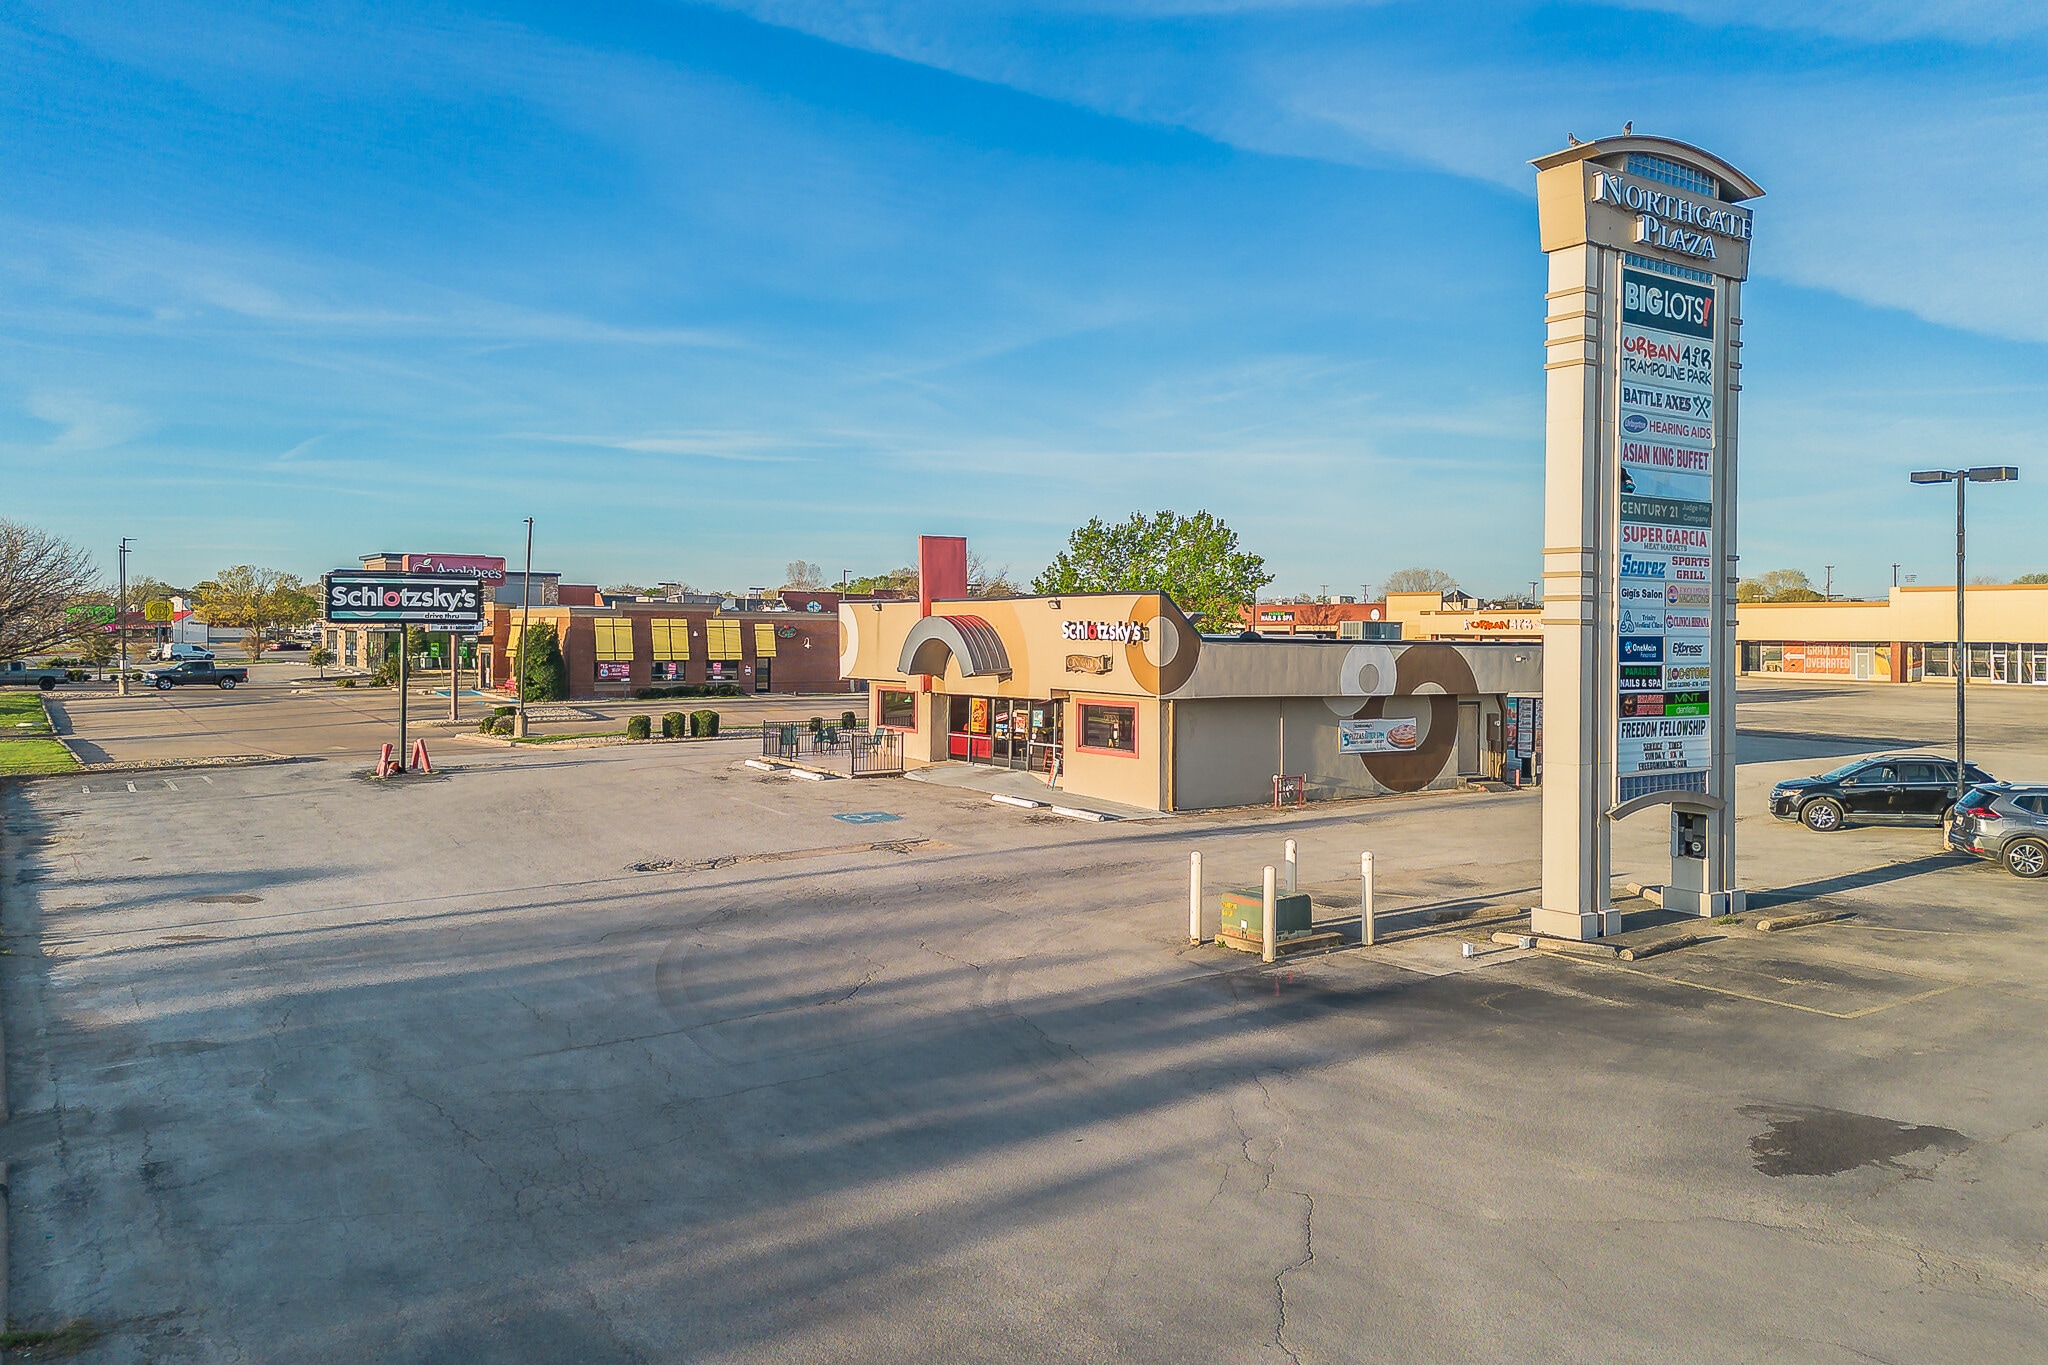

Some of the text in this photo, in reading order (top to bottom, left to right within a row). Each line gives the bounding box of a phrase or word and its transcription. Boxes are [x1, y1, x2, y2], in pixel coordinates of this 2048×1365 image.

[1592, 171, 1754, 241] NORTHGATE
[1634, 213, 1717, 260] PLAZA
[1623, 336, 1681, 364] URBAN
[1623, 357, 1712, 386] TRAMPOLINE PARK
[1623, 387, 1692, 412] BATTLE AXES
[1649, 420, 1689, 437] HEARING
[1690, 426, 1712, 440] AIDS
[1623, 442, 1709, 471] ASIAN KING BUFFET
[1621, 501, 1679, 518] CENTURY 21
[1623, 526, 1707, 547] SUPER GARCIA
[1643, 542, 1688, 552] MEAT MARKETS
[1621, 553, 1667, 576] Scorez
[1672, 556, 1710, 567] SPORTS
[1676, 570, 1706, 580] GRILL
[331, 586, 476, 612] Schlotzsky's
[1641, 589, 1663, 599] Salon
[1061, 620, 1142, 645] Schlotzsky's
[1470, 619, 1510, 631] URBAN
[1806, 645, 1849, 656] GRAVITY IS
[1625, 667, 1657, 676] PARADISE
[1806, 657, 1850, 669] OVERRATED
[1620, 679, 1640, 688] NAILS
[1648, 679, 1661, 688] SPA
[1674, 693, 1700, 704] MINT
[1621, 720, 1706, 739] FREEDOM FELLOWSHIP
[1644, 752, 1665, 760] SUNDAY
